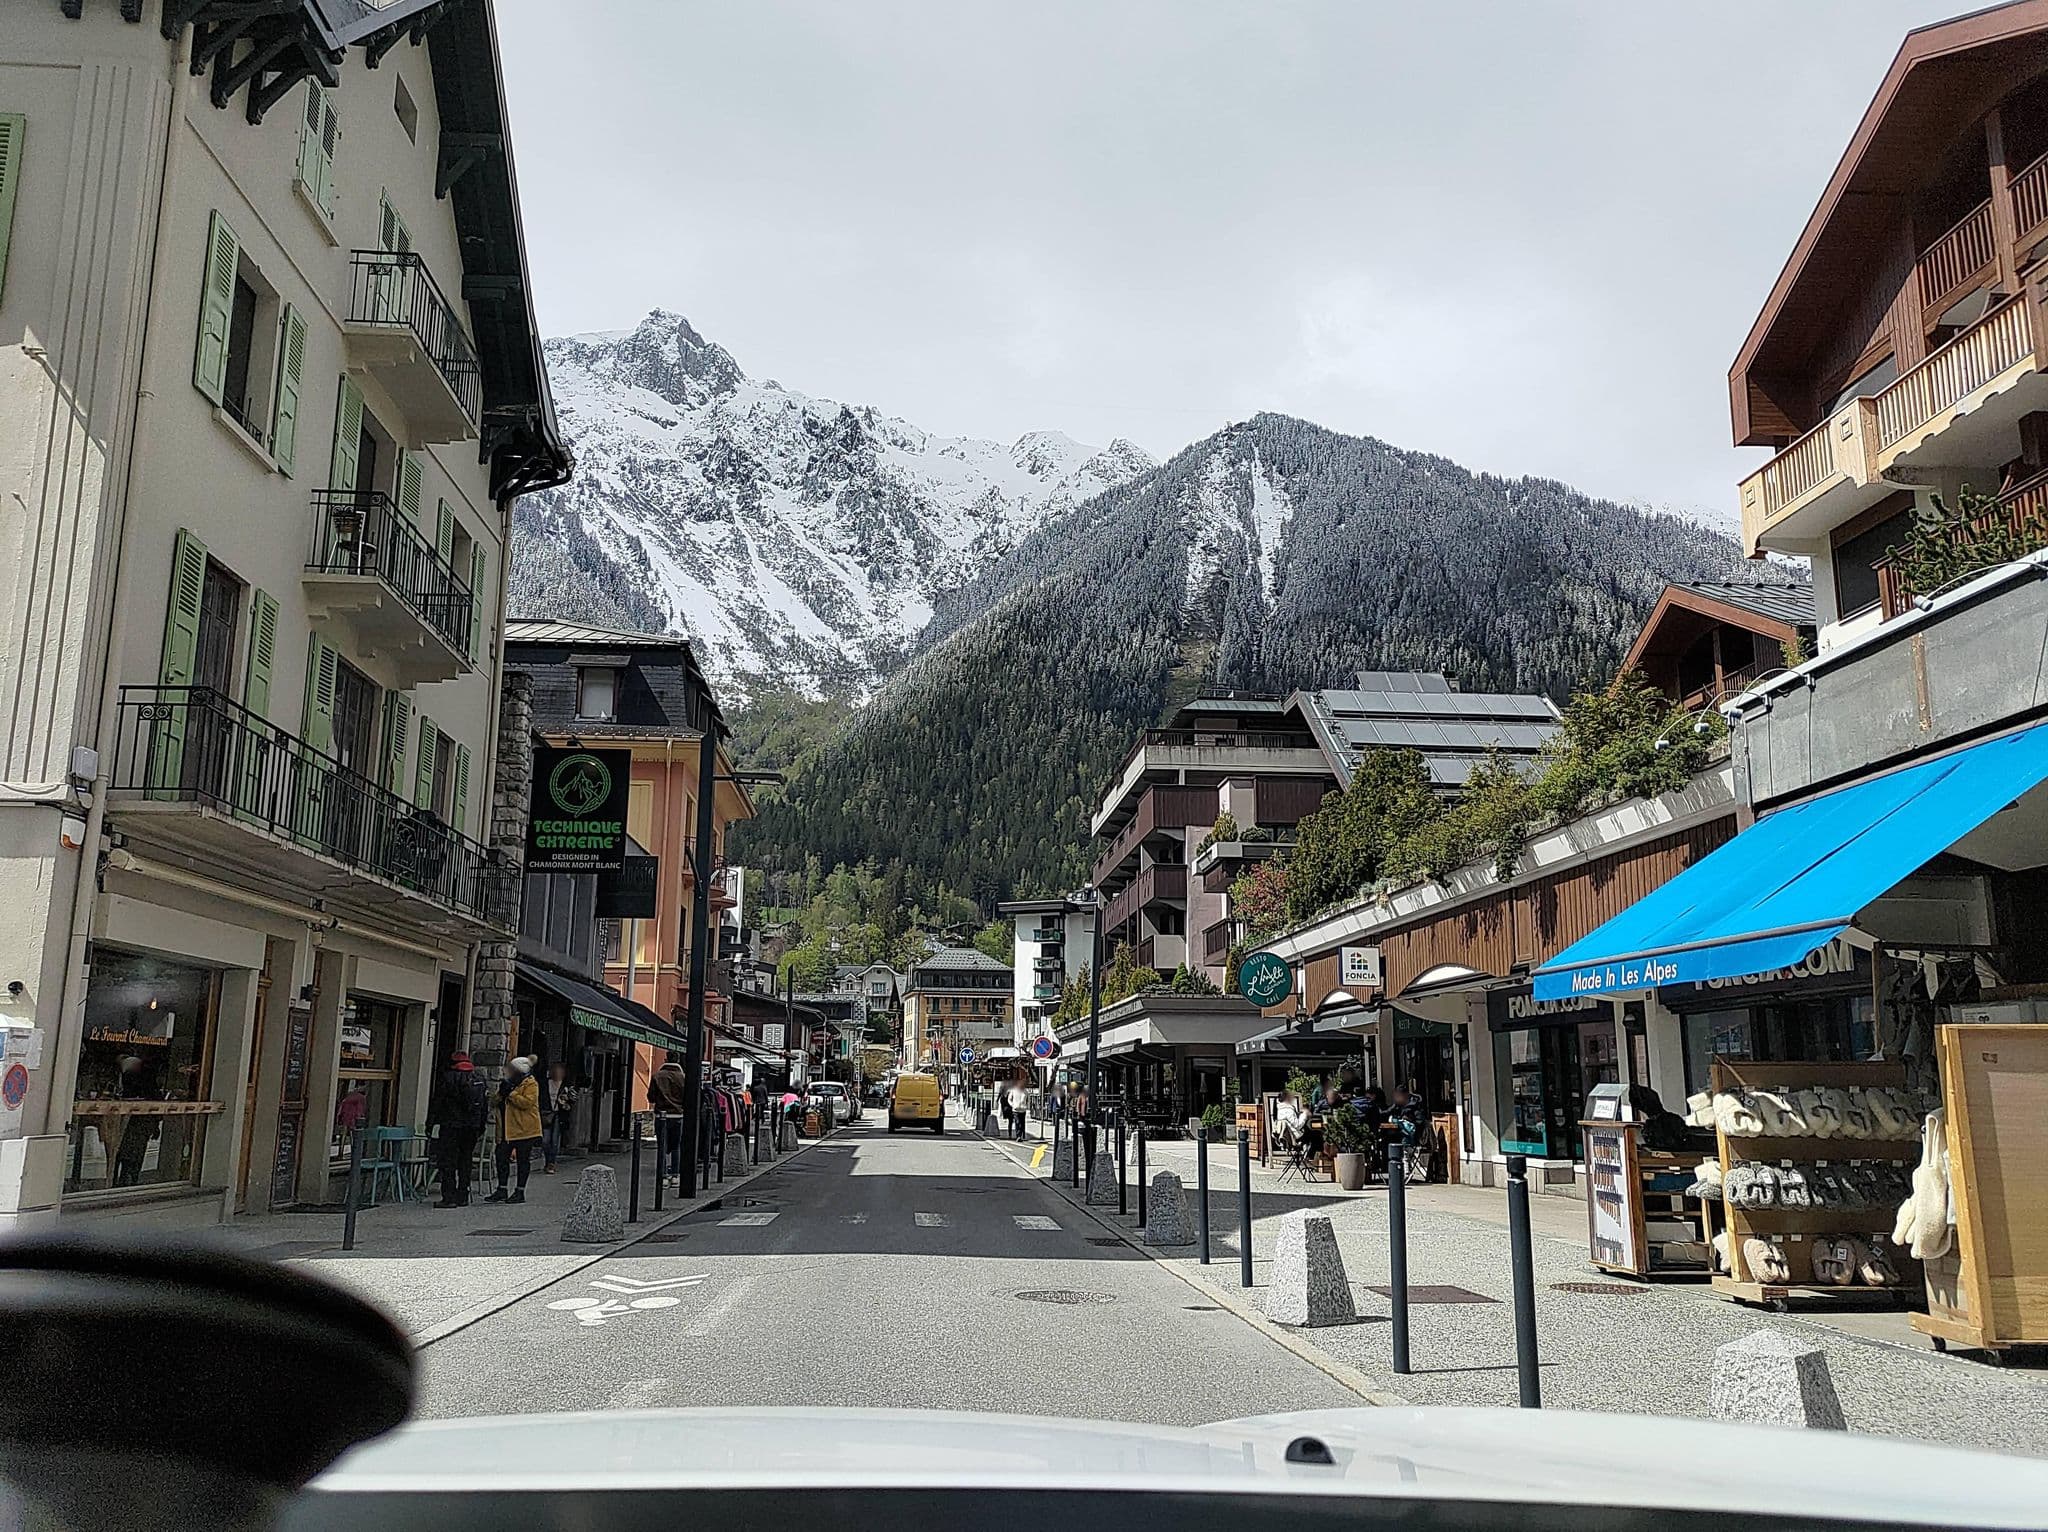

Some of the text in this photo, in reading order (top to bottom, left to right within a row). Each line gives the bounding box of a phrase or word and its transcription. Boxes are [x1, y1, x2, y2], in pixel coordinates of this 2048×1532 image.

[533, 820, 622, 834] TECHNIQUE
[536, 836, 614, 849] EXTREME
[552, 853, 589, 861] DESIGNED
[529, 861, 571, 869] CHAMONIX
[571, 861, 595, 869] MONT
[1345, 972, 1377, 980] FONCIA
[1572, 970, 1602, 992] Made
[1606, 967, 1616, 987] In
[1621, 964, 1639, 985] Les
[1644, 959, 1678, 984] Alpes
[89, 1026, 100, 1040] Le
